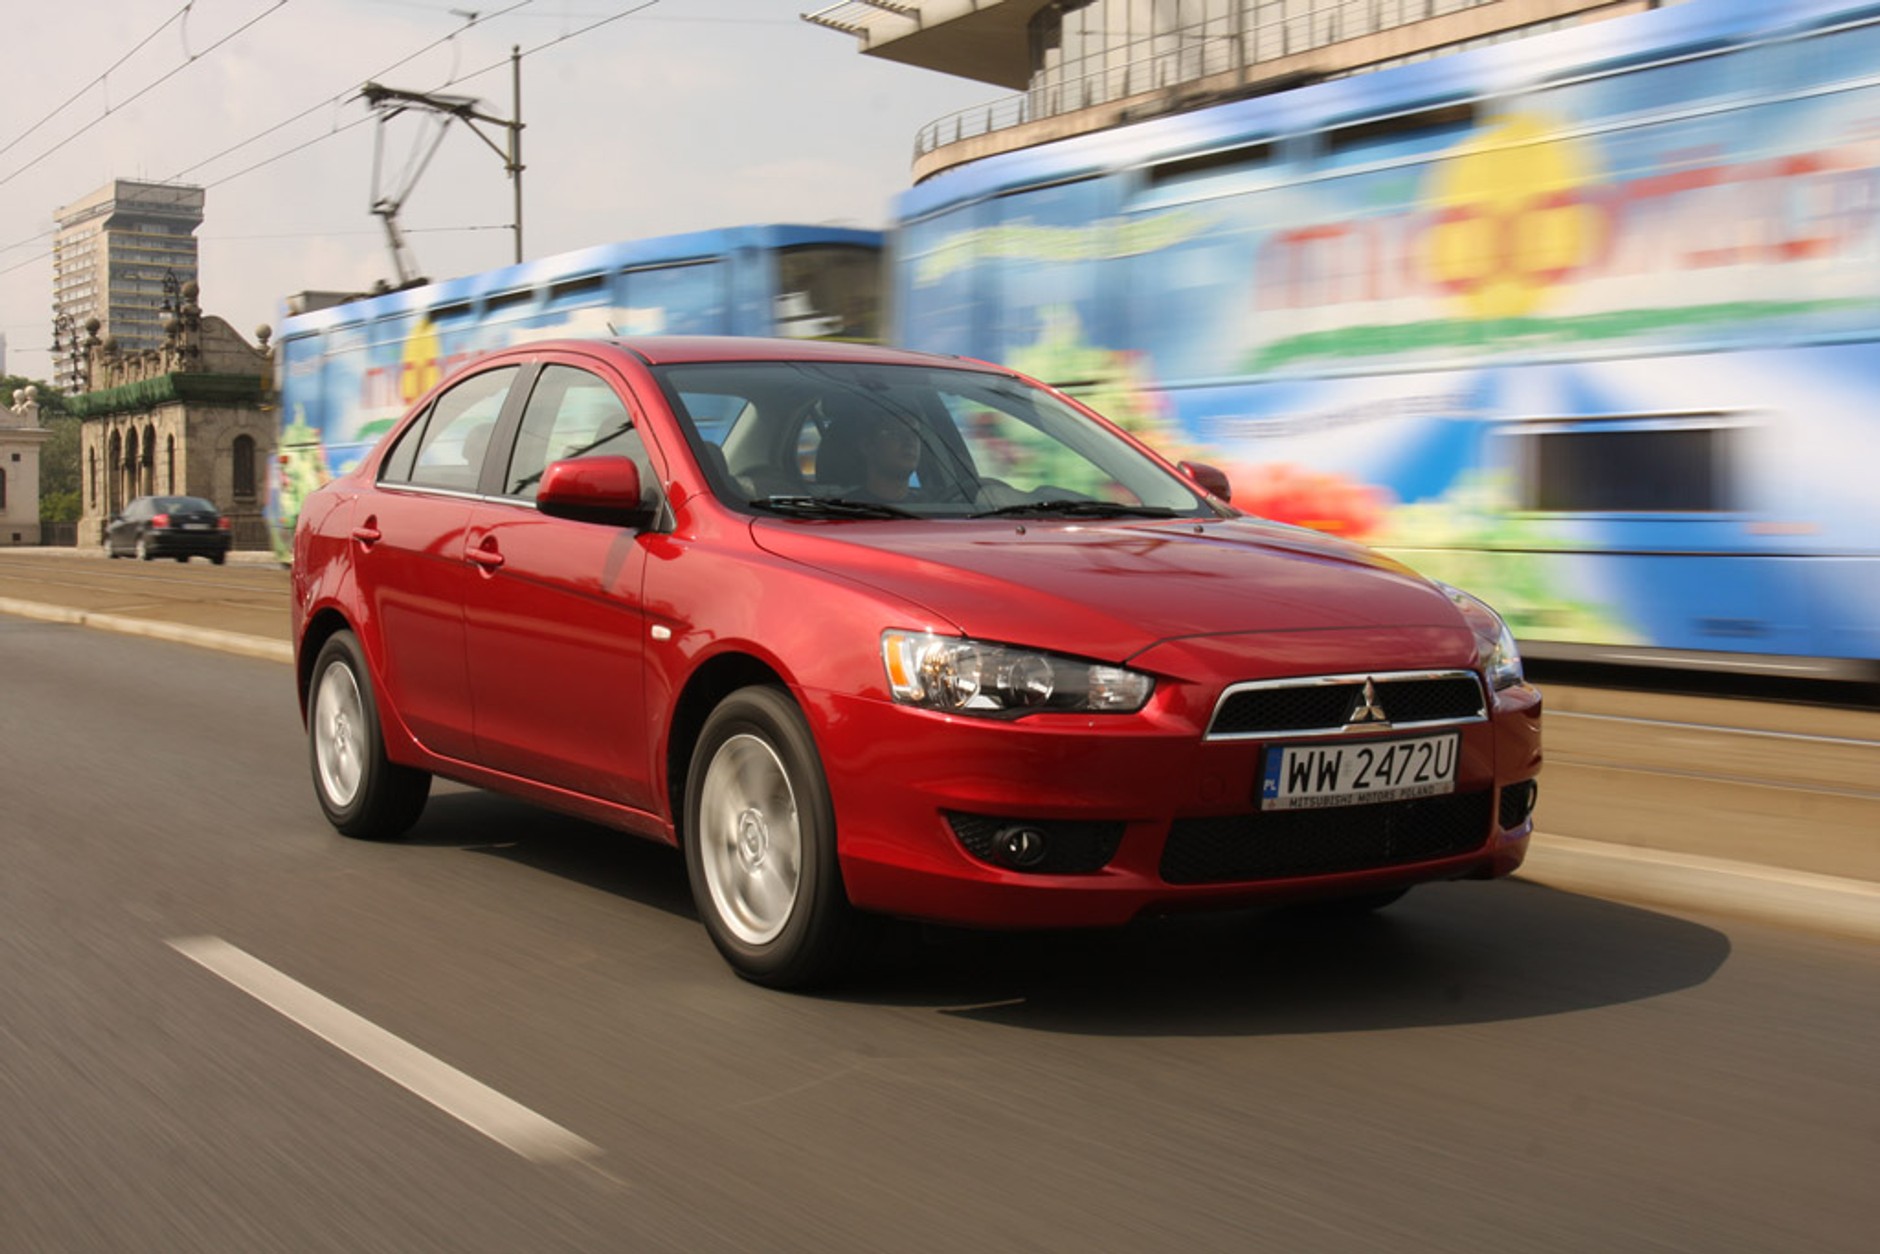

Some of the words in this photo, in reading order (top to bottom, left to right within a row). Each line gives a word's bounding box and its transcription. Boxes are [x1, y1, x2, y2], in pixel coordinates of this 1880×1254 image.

[1287, 751, 1343, 794] WW
[1352, 738, 1454, 789] 2472U
[1263, 779, 1277, 791] PL
[1289, 794, 1354, 808] MITSUBISHI
[1358, 790, 1396, 803] MOTORS
[1401, 785, 1435, 799] POLAND
